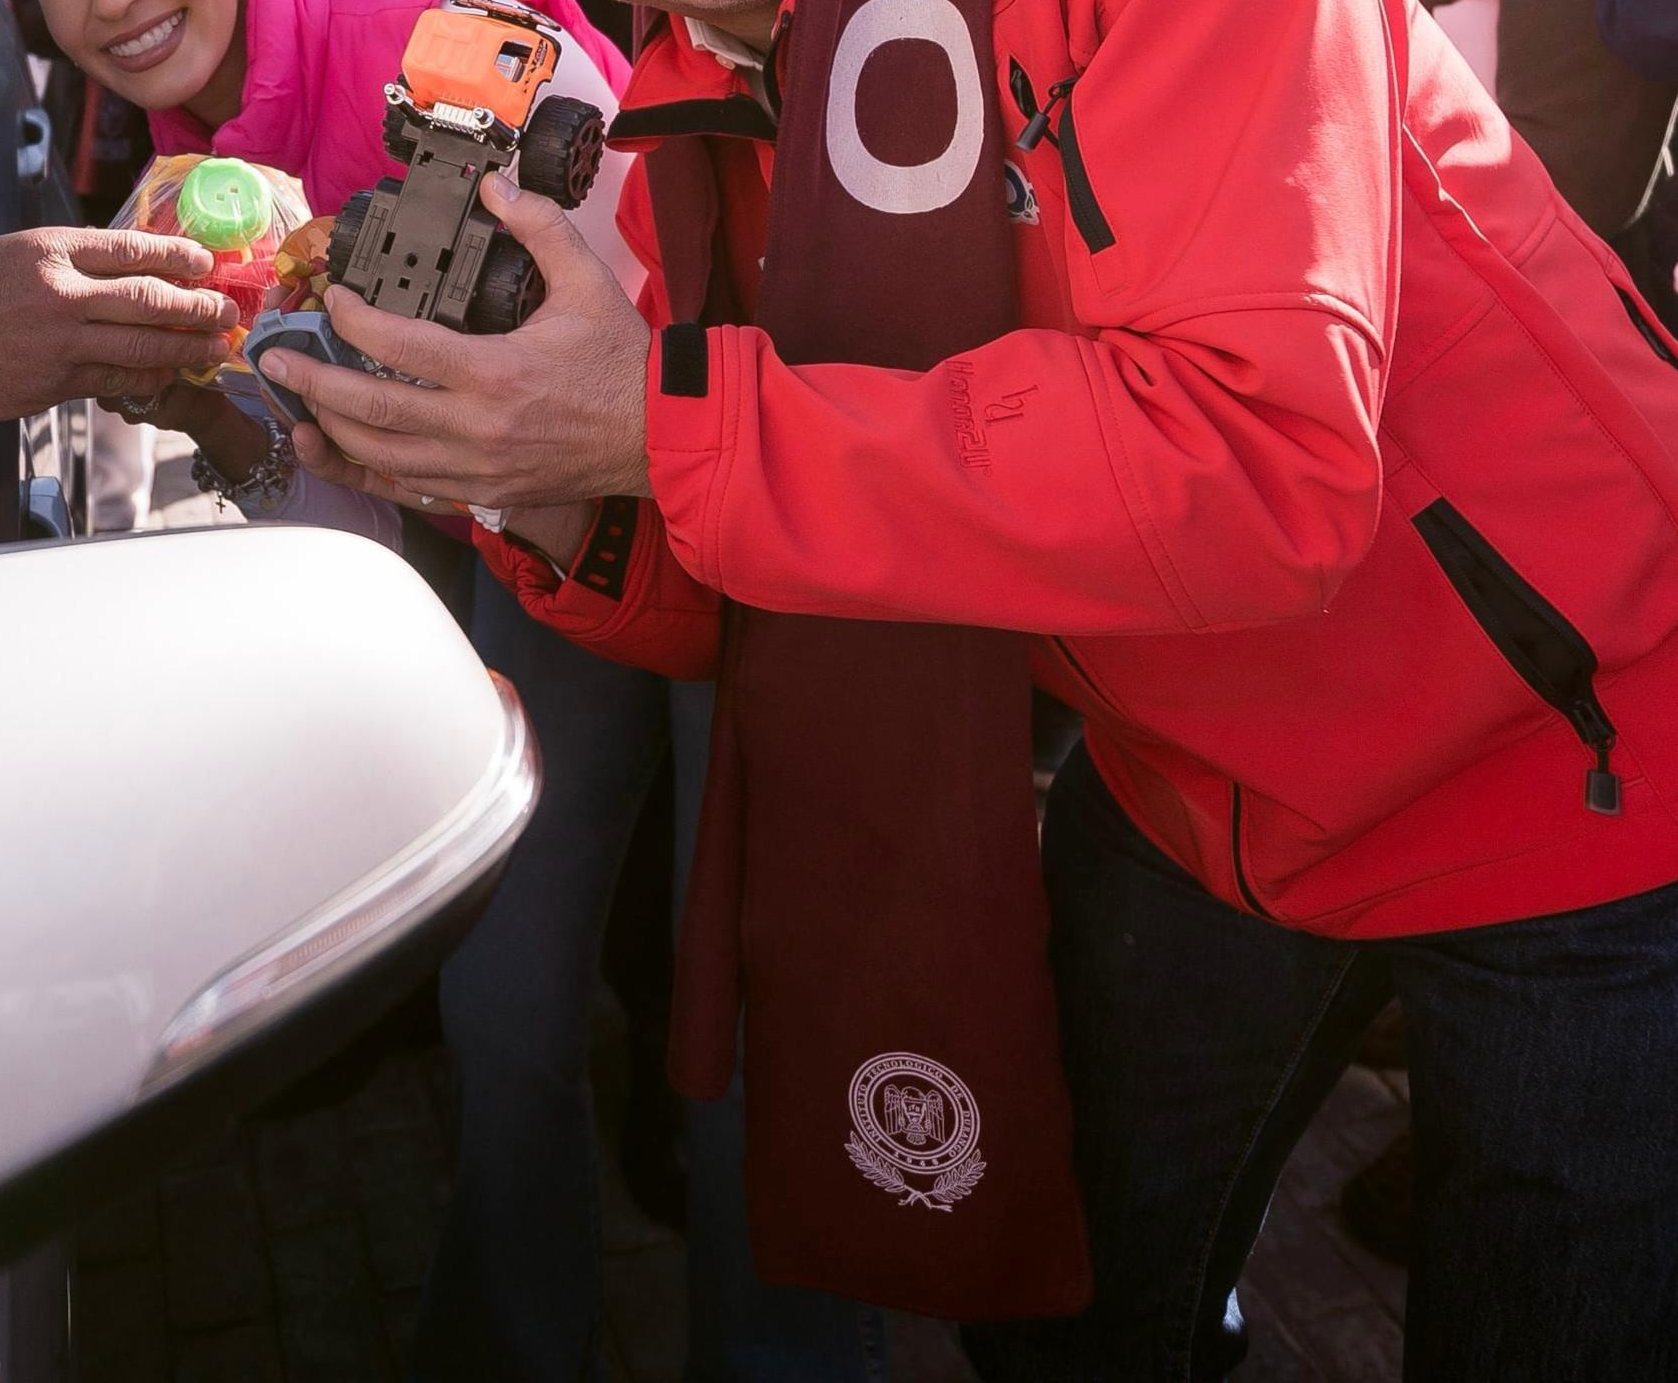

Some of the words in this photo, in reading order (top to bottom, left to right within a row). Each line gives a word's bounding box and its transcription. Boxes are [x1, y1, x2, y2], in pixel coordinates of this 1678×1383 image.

[866, 1059, 943, 1080] TECNOLOGICO
[950, 1084, 964, 1099] DE
[857, 1084, 882, 1143] INSTITUTO
[948, 1110, 971, 1158] DURANGO
